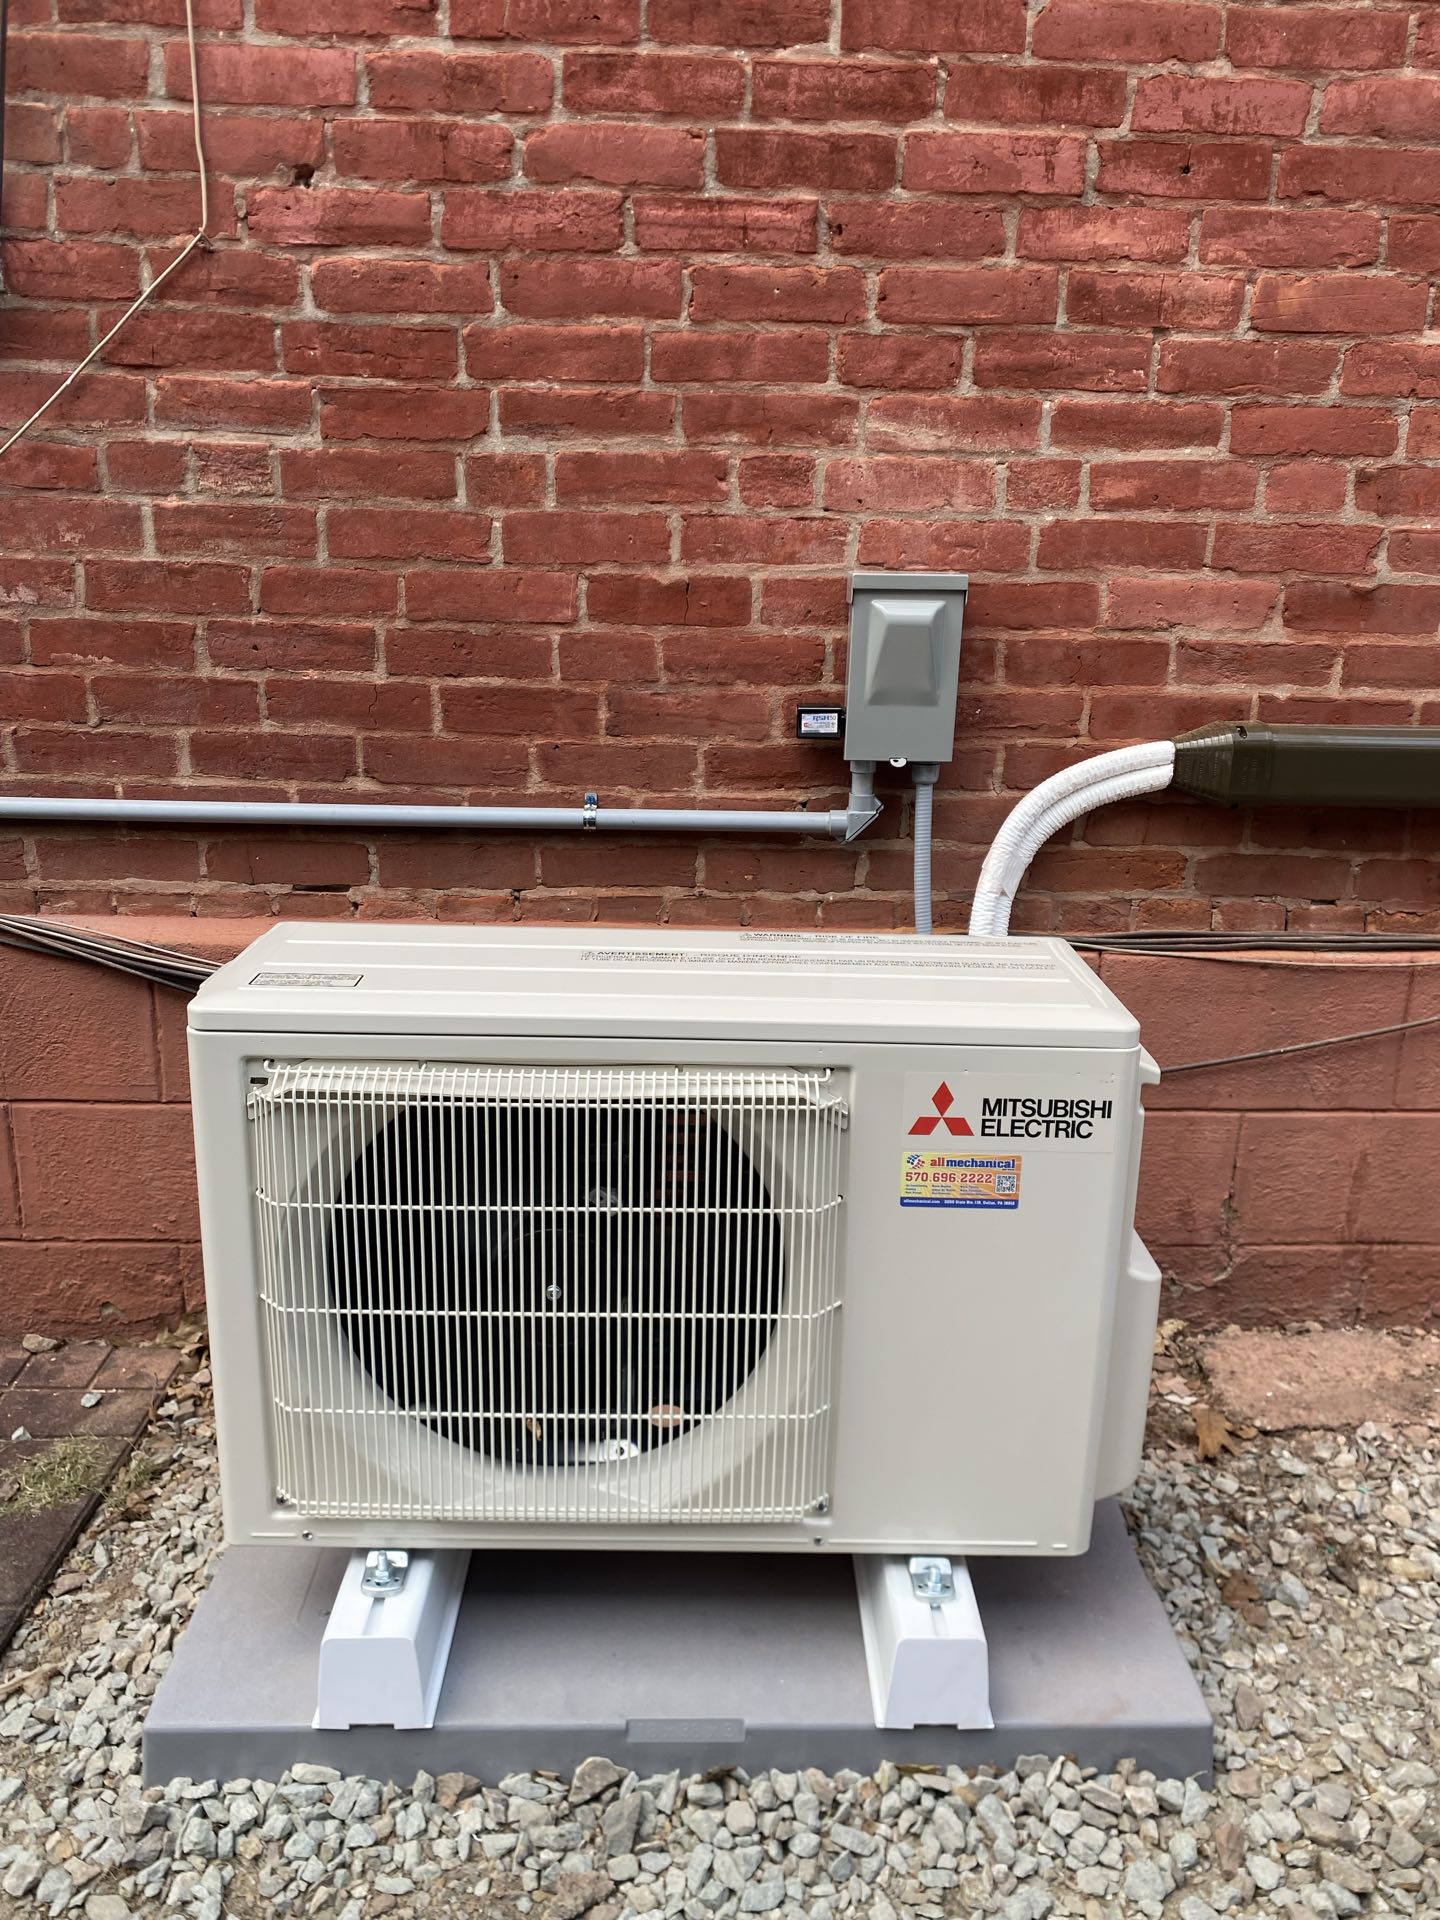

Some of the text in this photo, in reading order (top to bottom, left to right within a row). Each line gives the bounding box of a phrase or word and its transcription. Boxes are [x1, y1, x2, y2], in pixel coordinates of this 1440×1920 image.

[981, 1097, 1113, 1119] MITSUBISHI
[980, 1118, 1094, 1139] ELECTRIC
[930, 1156, 1016, 1169] all mechanical
[905, 1171, 993, 1184] 570.696.2222
